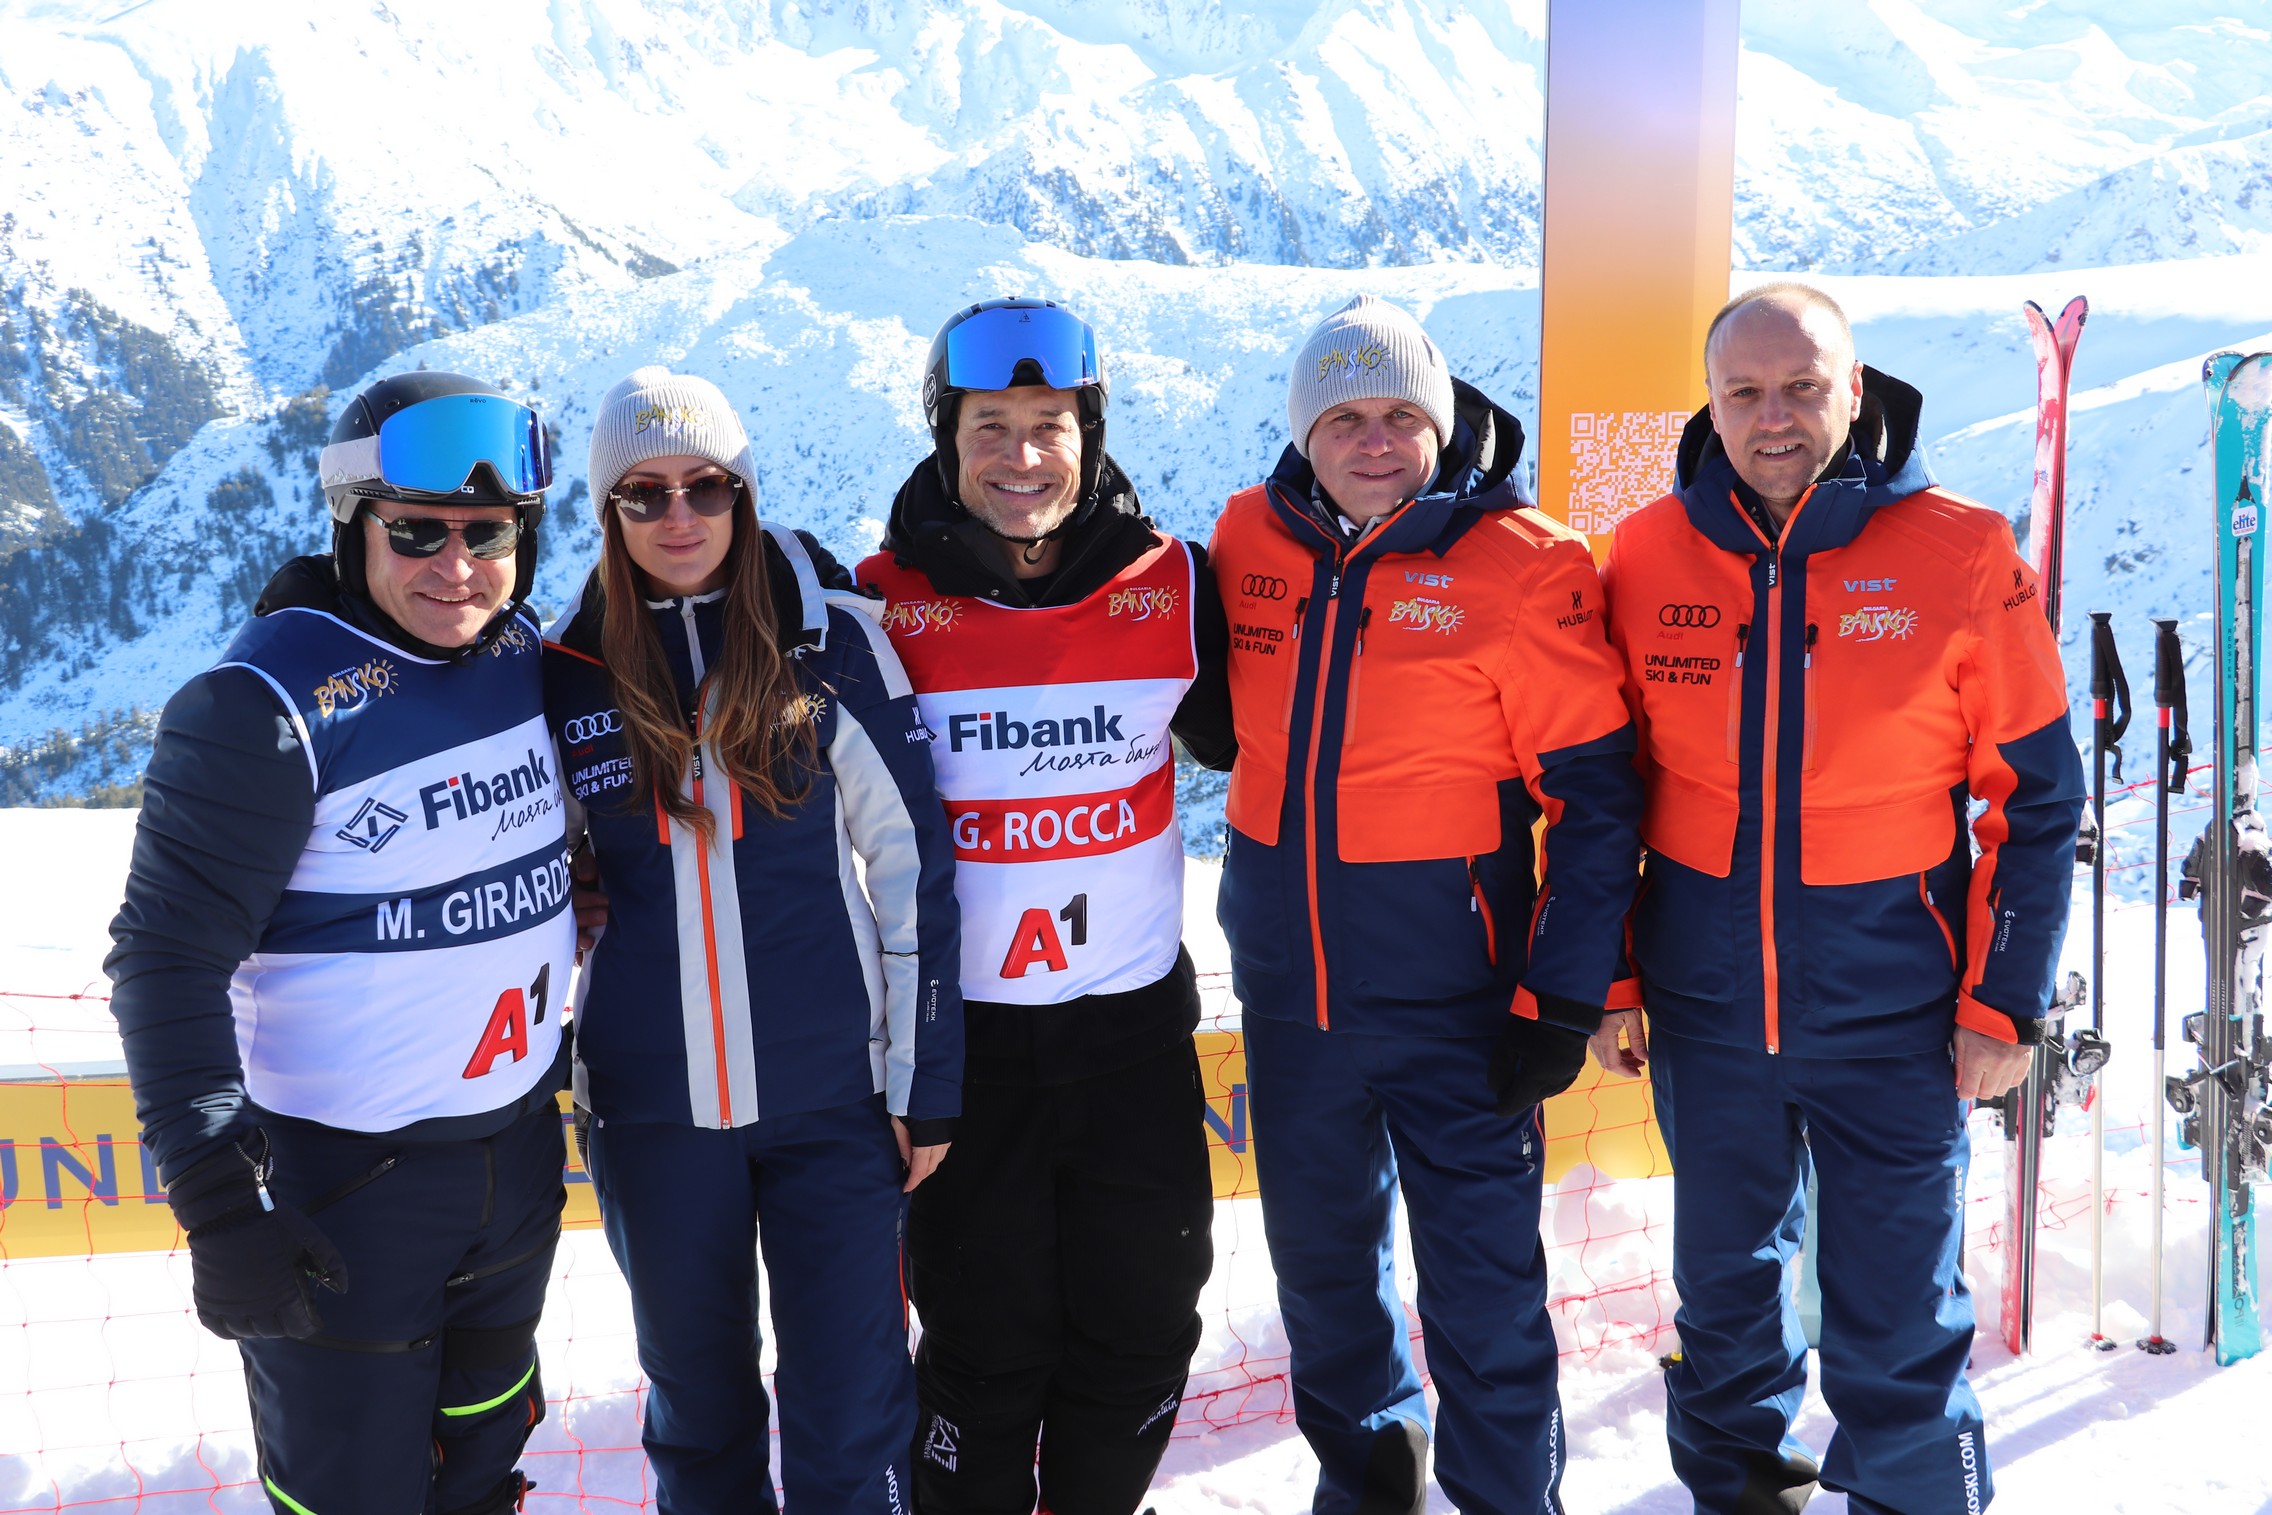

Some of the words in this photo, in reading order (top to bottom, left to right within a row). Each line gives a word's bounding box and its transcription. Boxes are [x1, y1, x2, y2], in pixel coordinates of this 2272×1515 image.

[1318, 343, 1385, 382] BANSKO
[2233, 511, 2256, 530] elite
[1108, 587, 1174, 622] BANSKO
[1239, 600, 1258, 610] Audi
[1388, 597, 1460, 632] BANSKO
[1233, 623, 1284, 643] UNLIMITED
[1656, 631, 1684, 641] Audi
[1838, 607, 1913, 642] BANSKO
[1233, 637, 1244, 650] SKI
[1245, 640, 1252, 651] &
[1252, 641, 1277, 656] FUN
[332, 666, 357, 678] BULGARIA
[1645, 653, 1721, 671] UNLIMITED
[313, 662, 392, 719] BANSKO
[1645, 669, 1665, 682] SKI
[1667, 671, 1678, 683] &
[1681, 672, 1712, 686] FUN
[949, 705, 1125, 752] Fibank
[419, 748, 551, 831] Fibank
[591, 781, 600, 793] &
[953, 811, 992, 850] G.
[1004, 798, 1136, 850] ROCCA
[377, 898, 425, 940] M.
